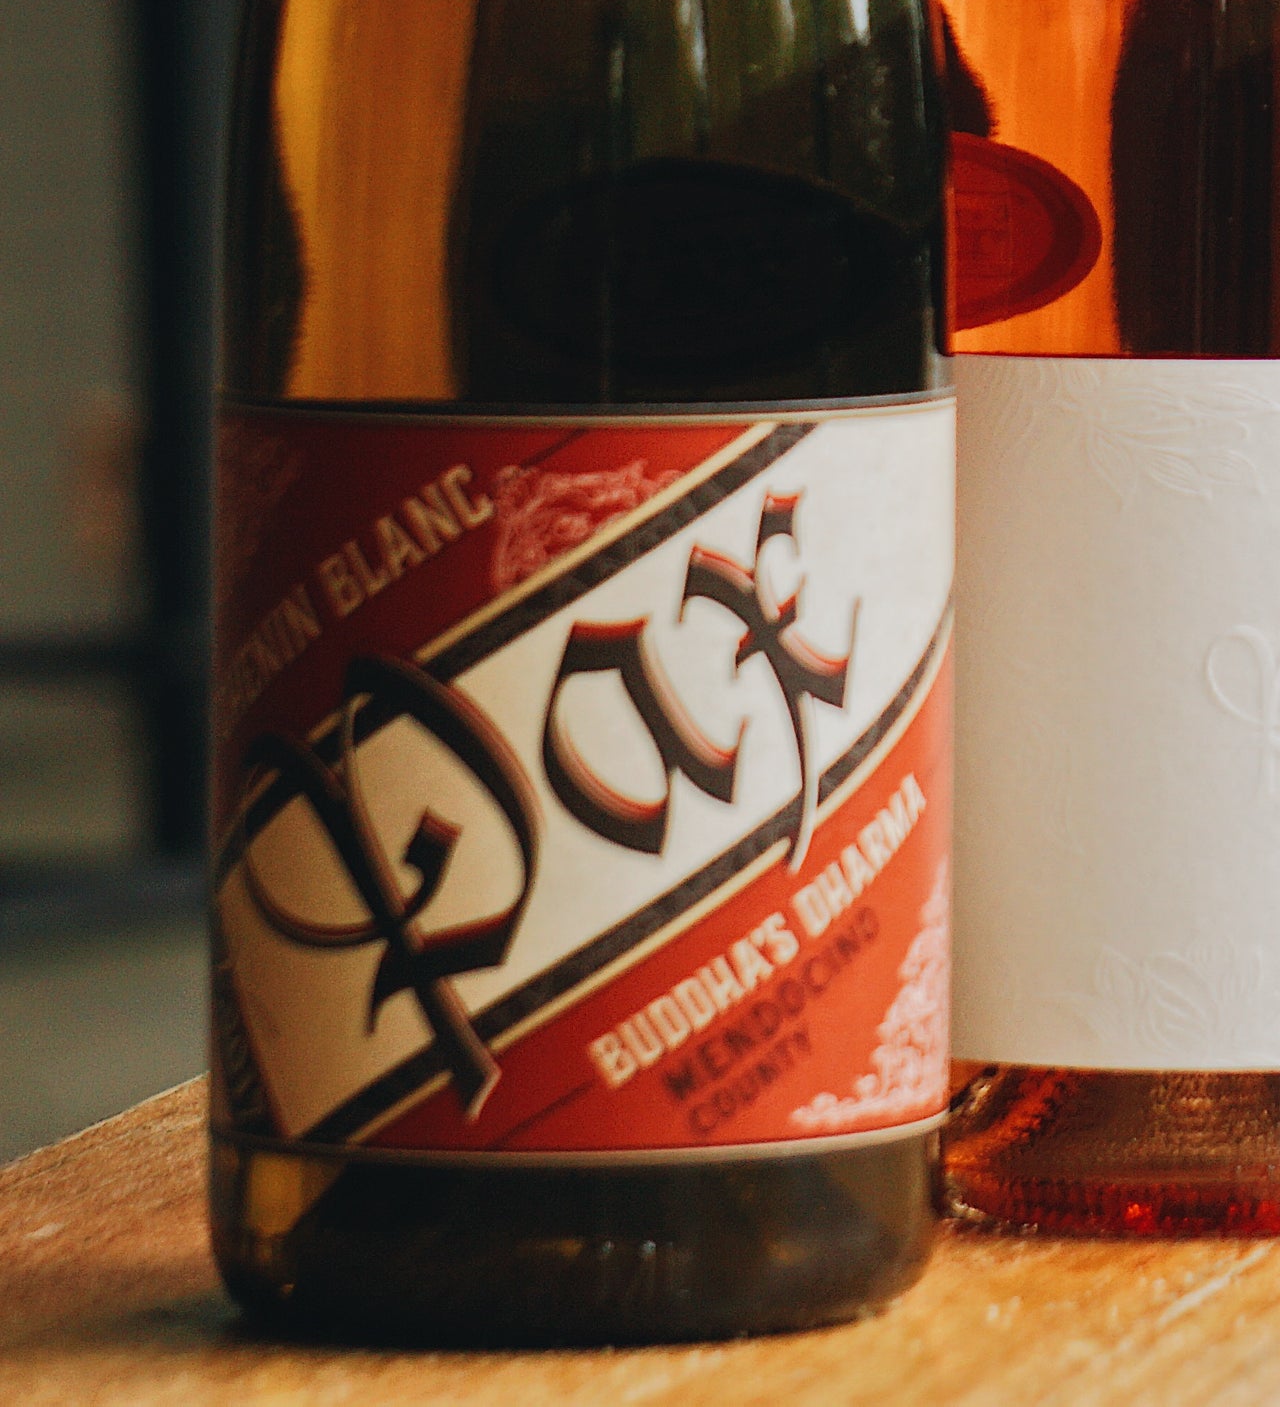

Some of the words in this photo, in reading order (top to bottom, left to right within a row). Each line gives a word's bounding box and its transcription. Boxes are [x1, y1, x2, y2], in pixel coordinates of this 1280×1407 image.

[318, 463, 497, 614] BLANC
[245, 487, 863, 1121] Pax
[791, 770, 928, 939] DHARMA
